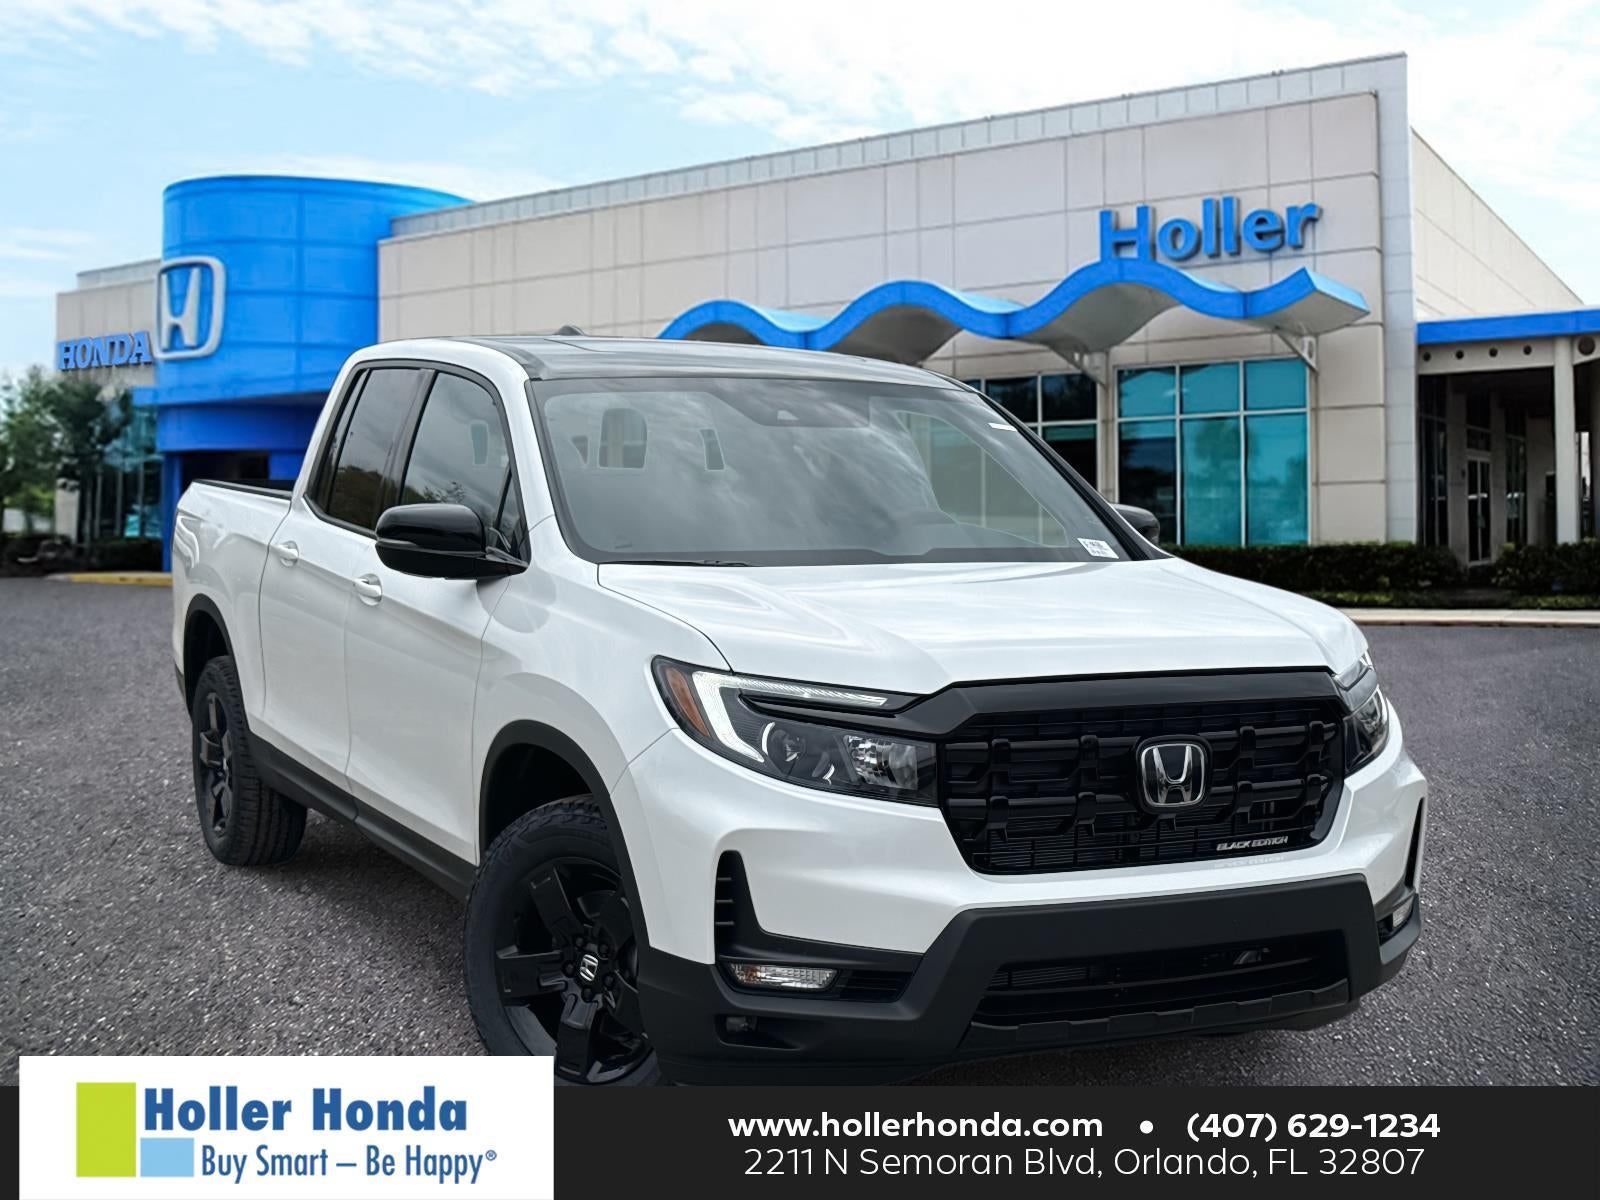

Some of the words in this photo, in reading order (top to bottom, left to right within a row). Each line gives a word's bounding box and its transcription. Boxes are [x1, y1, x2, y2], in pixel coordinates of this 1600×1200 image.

[1098, 196, 1323, 262] Holler
[57, 331, 152, 371] HONDA
[1216, 840, 1251, 851] BLACK
[1251, 836, 1288, 847] EDITION
